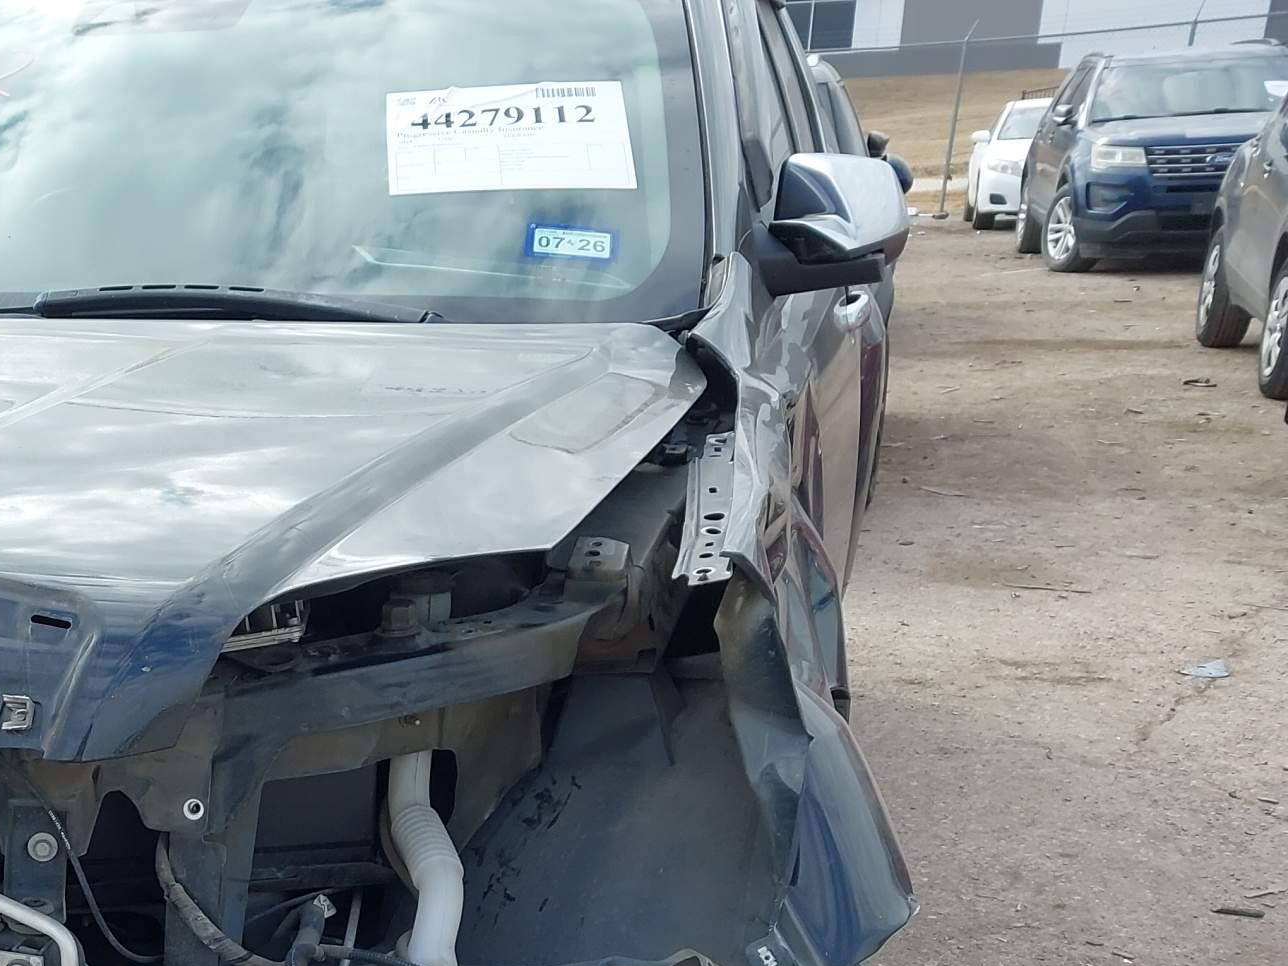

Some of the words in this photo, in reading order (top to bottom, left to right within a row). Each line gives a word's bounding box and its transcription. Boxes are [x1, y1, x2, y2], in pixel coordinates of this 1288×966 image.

[410, 105, 596, 129] 44279112
[538, 235, 565, 249] 07
[577, 239, 606, 253] 26
